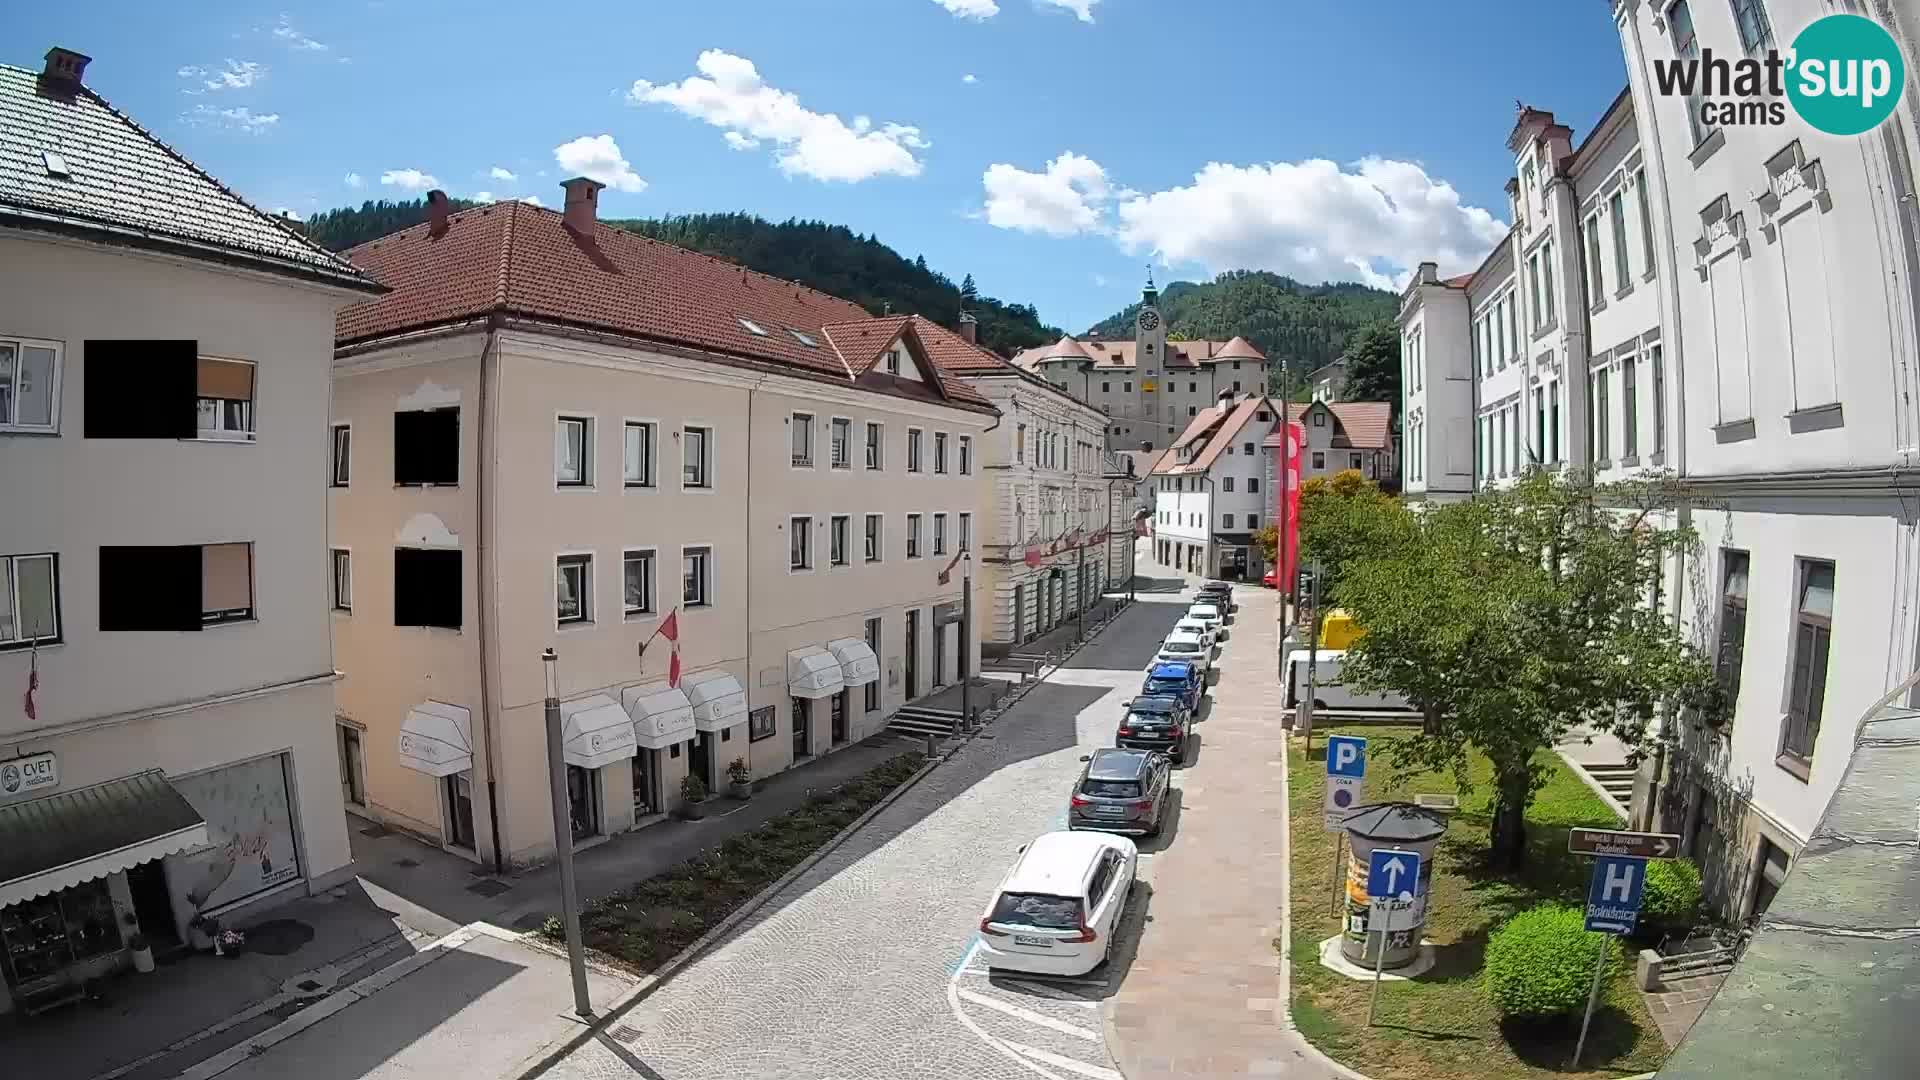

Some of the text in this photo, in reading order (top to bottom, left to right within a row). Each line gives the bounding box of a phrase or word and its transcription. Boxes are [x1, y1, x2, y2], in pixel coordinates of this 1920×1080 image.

[23, 759, 52, 776] CVET
[1336, 742, 1357, 771] P
[1602, 863, 1635, 903] H
